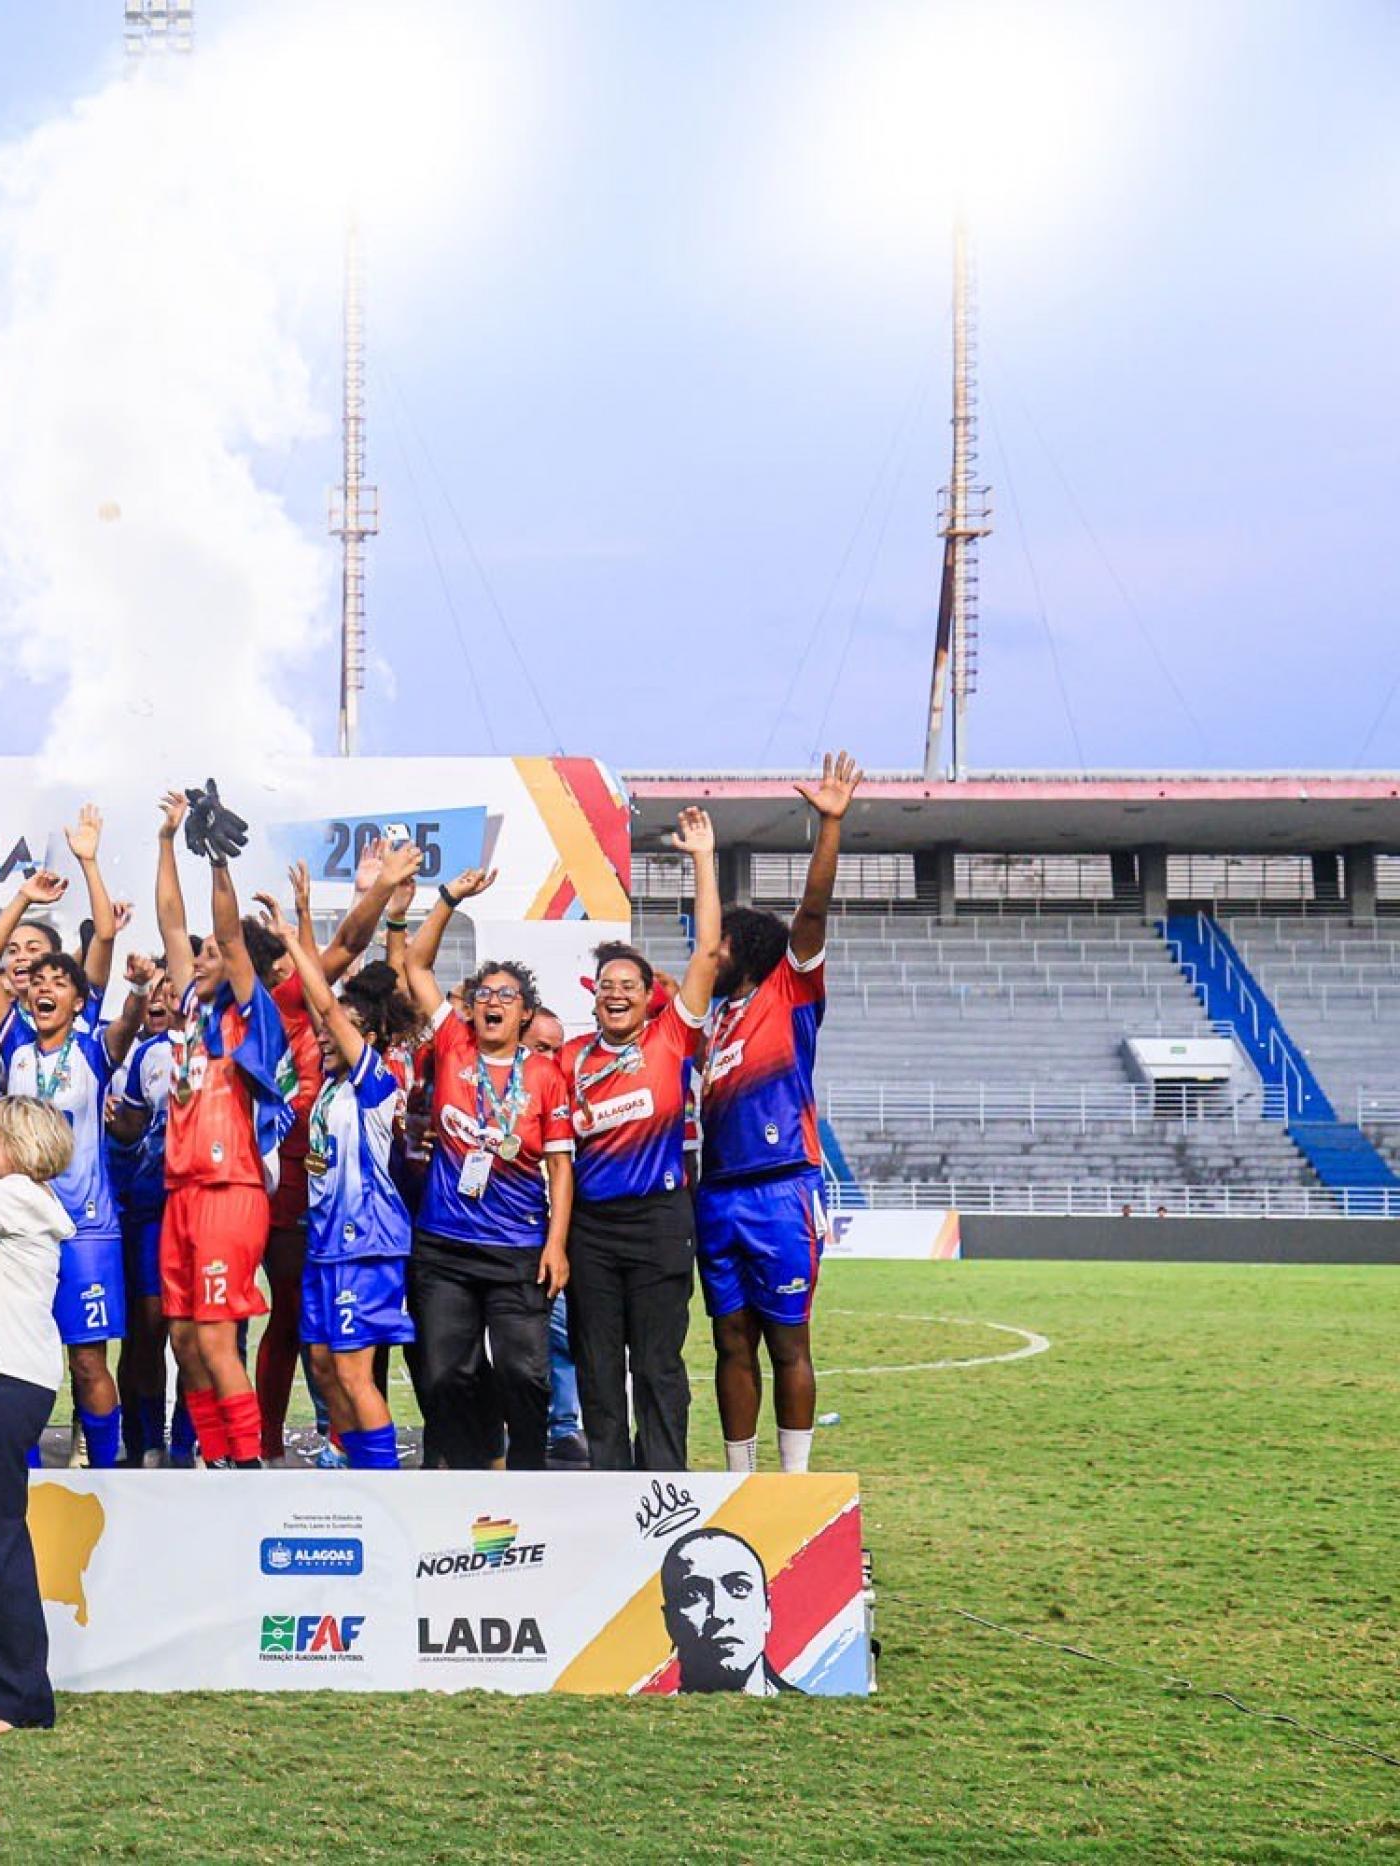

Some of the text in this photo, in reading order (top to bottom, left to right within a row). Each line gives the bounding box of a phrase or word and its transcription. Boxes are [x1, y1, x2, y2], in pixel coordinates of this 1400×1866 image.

[324, 822, 441, 878] 205
[204, 1277, 227, 1305] 12
[85, 1300, 109, 1328] 21
[339, 1307, 356, 1335] 2
[294, 1549, 355, 1562] ALAGOAS
[415, 1542, 547, 1579] NORDESTE
[296, 1615, 367, 1652] FAF
[417, 1617, 548, 1654] LADA
